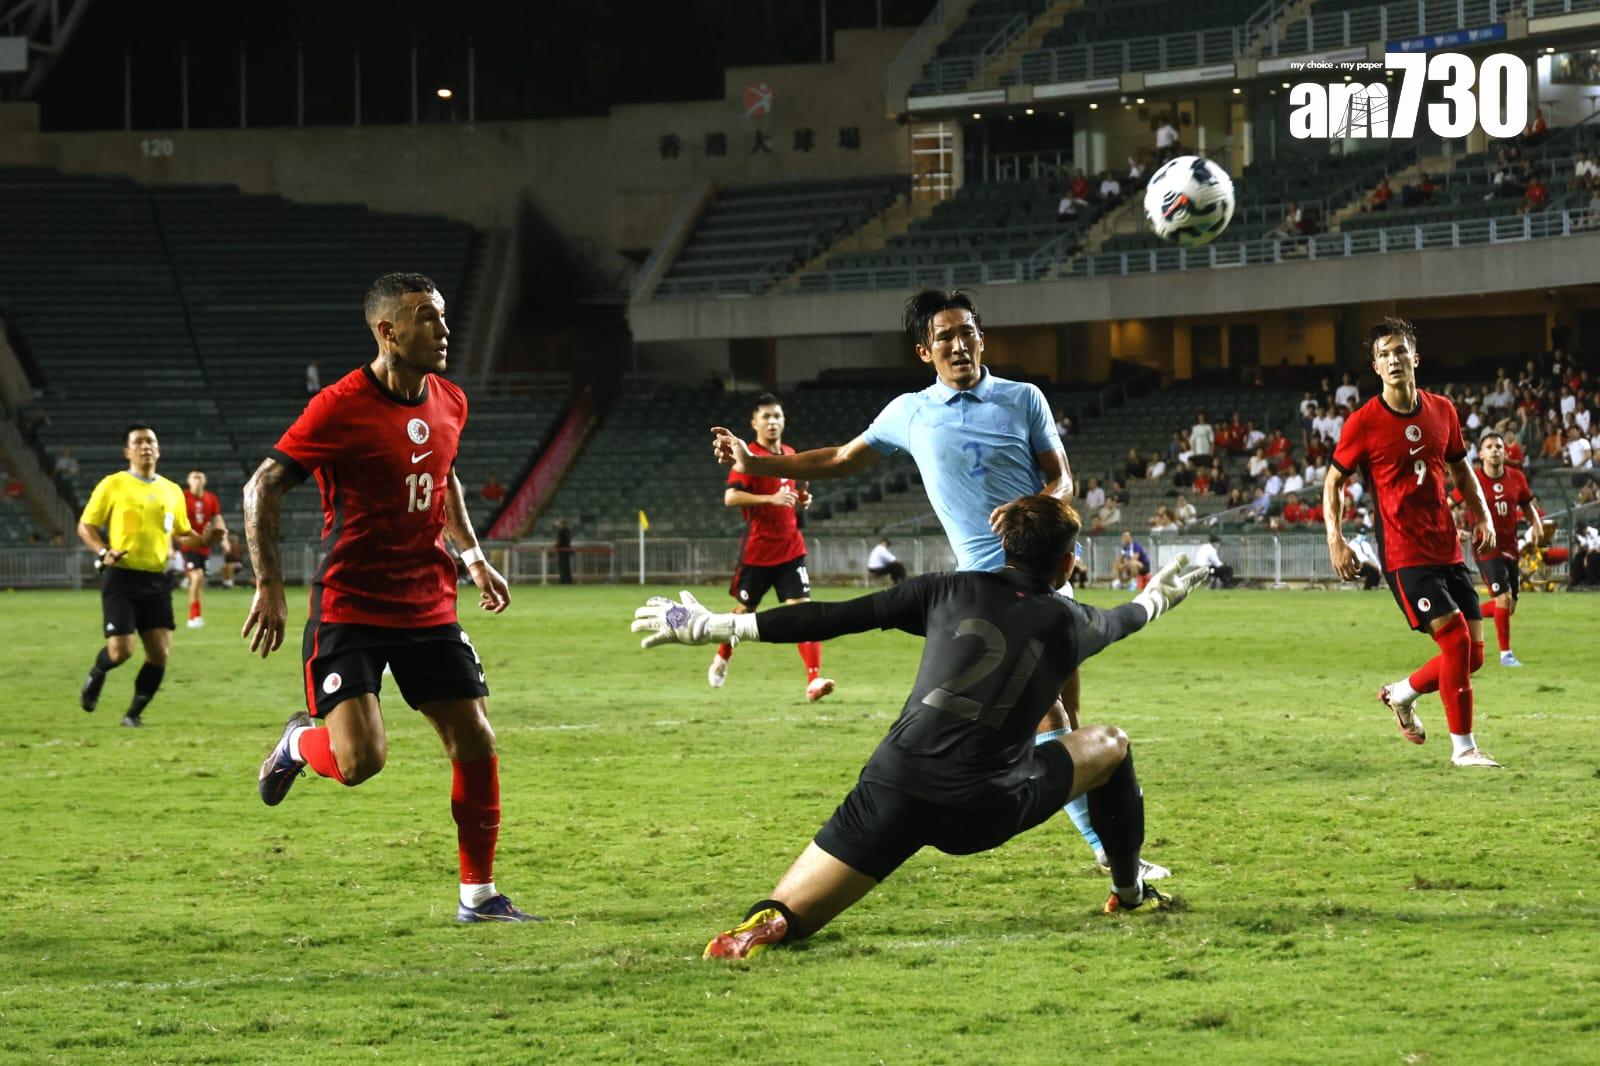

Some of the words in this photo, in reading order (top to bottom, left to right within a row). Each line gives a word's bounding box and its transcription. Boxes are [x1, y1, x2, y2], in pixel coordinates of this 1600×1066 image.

[141, 139, 174, 157] 120
[962, 441, 990, 478] 2
[1413, 459, 1427, 486] 9
[405, 472, 433, 513] 13
[1494, 500, 1508, 517] 10
[921, 618, 1045, 731] 21
